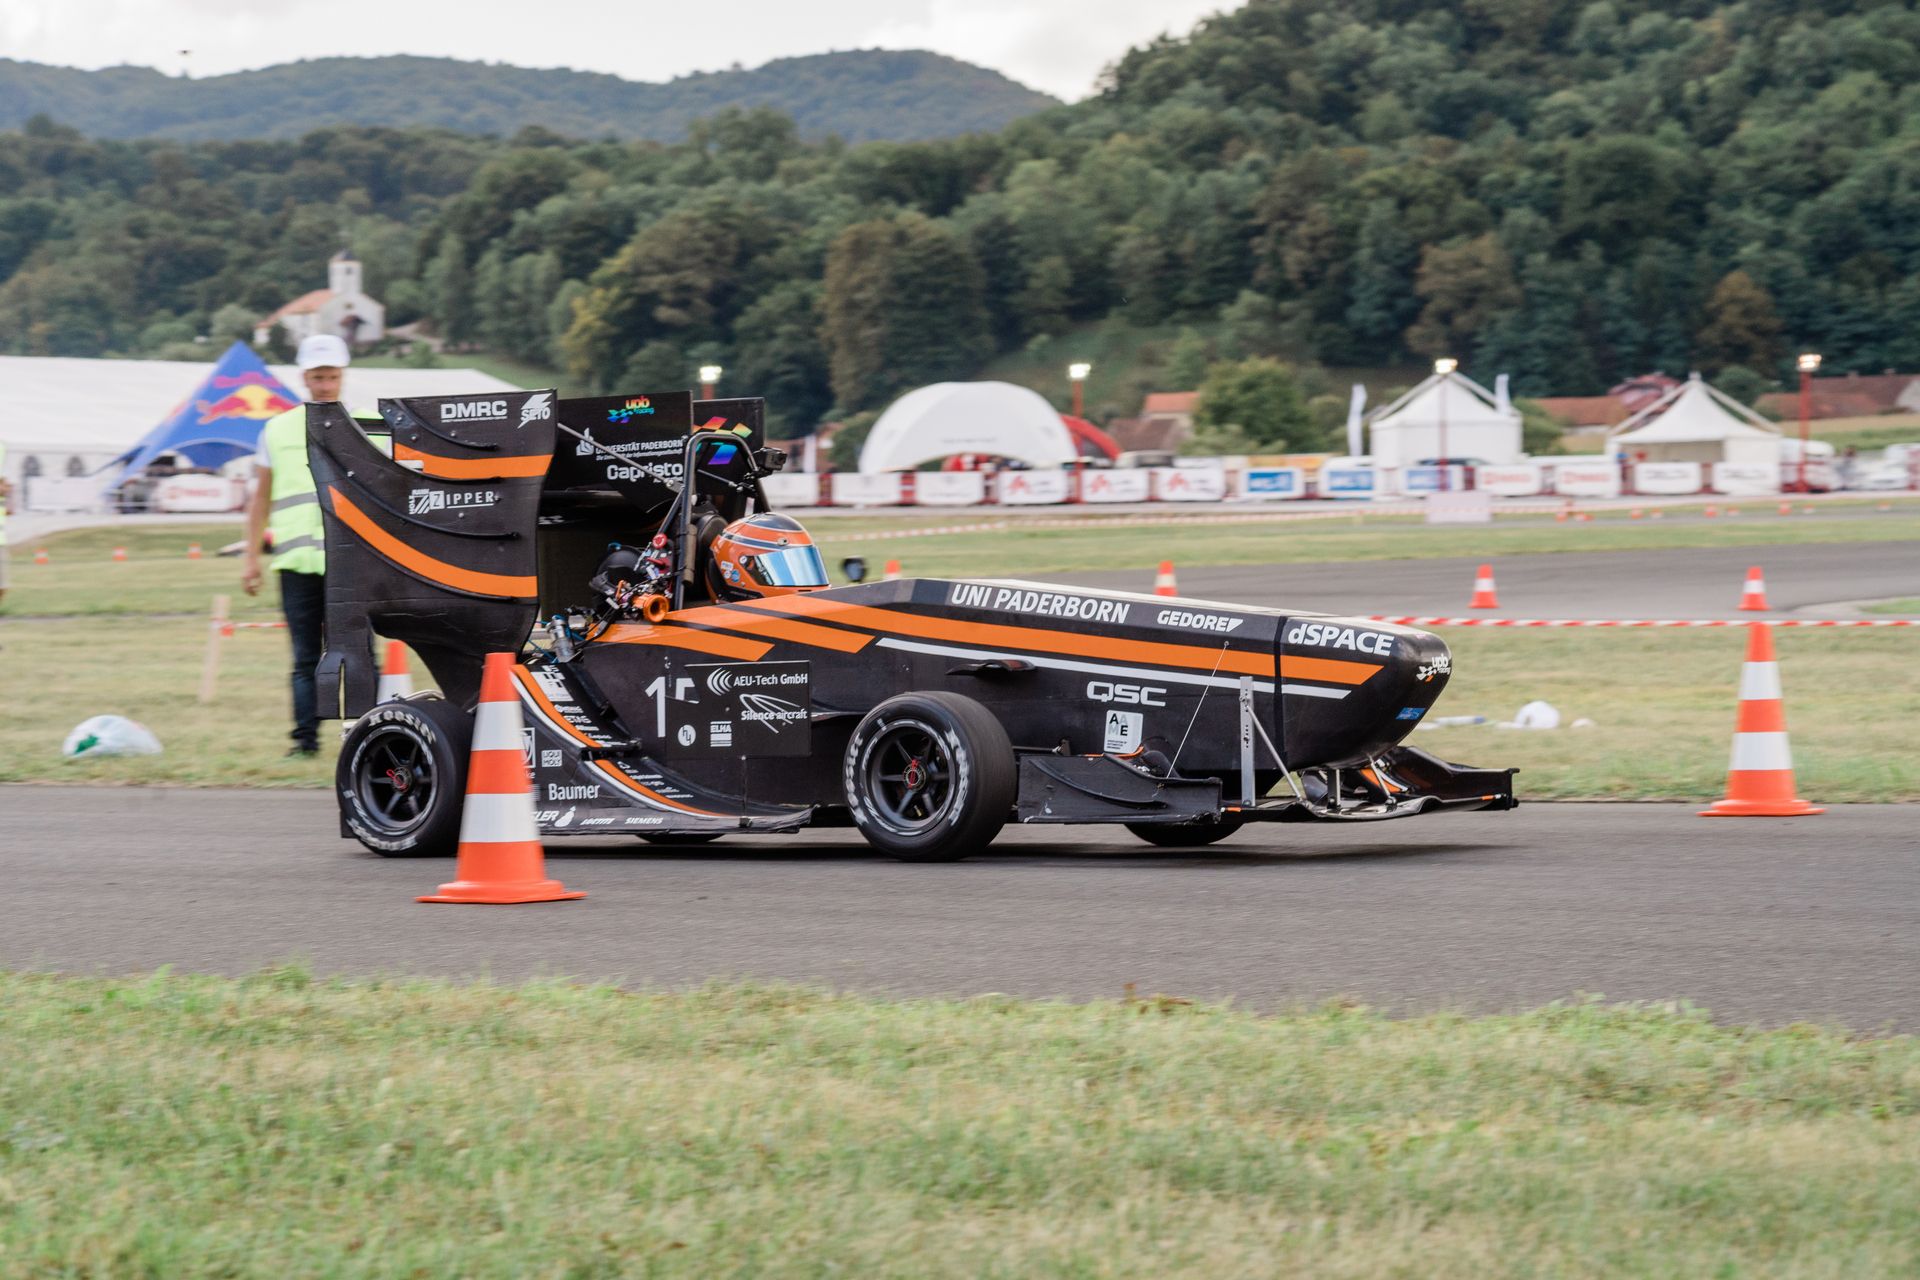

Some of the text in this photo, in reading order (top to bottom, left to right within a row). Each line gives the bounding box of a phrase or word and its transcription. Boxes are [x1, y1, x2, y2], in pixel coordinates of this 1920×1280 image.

[441, 400, 508, 419] DMRC
[625, 395, 650, 409] upb
[429, 490, 494, 510] ZIPPER
[951, 583, 1130, 624] UNI PADERBORN
[1157, 610, 1231, 632] GEDORE
[1287, 623, 1395, 656] dSPACE
[733, 673, 808, 687] AEU-Tech GmbH
[1087, 680, 1167, 707] QSC
[741, 708, 808, 721] Silence aircraft
[548, 783, 600, 801] Baumer
